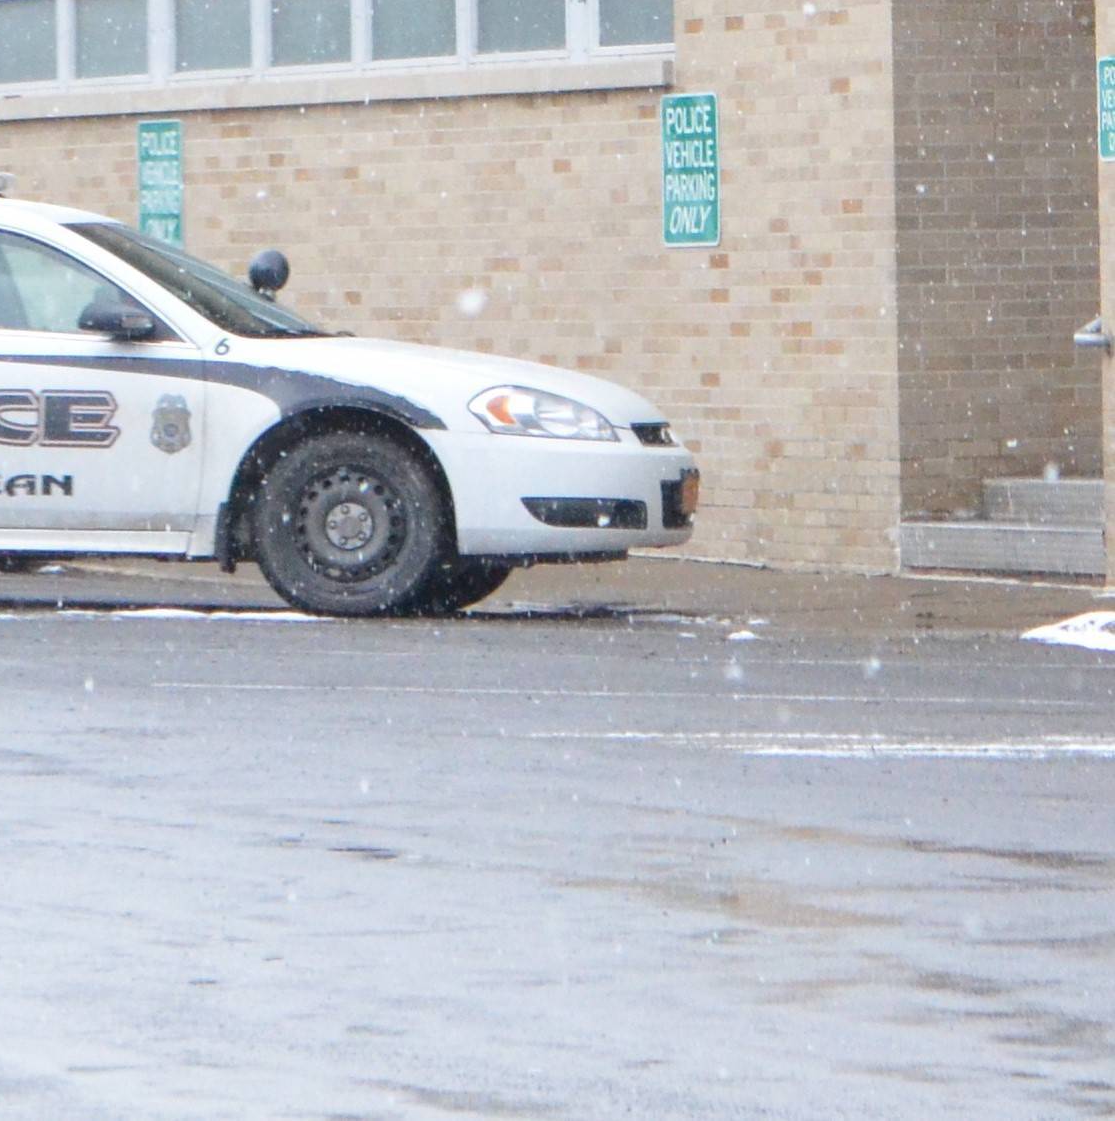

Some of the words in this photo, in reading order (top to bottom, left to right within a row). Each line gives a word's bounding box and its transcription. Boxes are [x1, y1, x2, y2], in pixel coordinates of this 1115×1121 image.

[666, 106, 712, 134] POLICE
[664, 140, 715, 168] VEHICLE
[665, 171, 716, 201] PARKING
[669, 205, 712, 234] ONLY
[215, 338, 231, 356] 6
